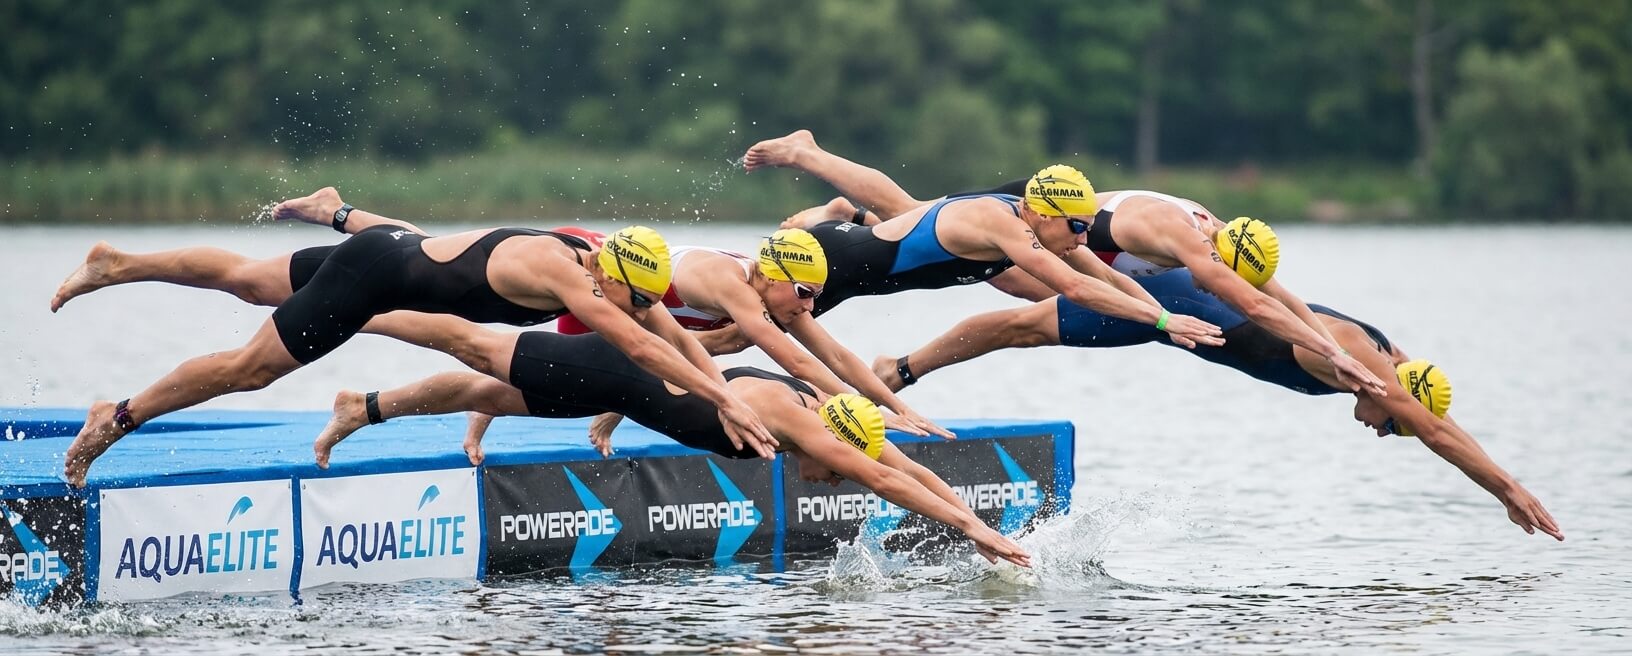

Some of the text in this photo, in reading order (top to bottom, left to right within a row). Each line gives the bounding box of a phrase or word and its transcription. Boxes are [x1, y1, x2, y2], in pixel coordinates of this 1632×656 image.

[951, 480, 1039, 511] WERADE
[500, 508, 616, 542] POWERADE
[648, 500, 755, 532] POWERADE
[115, 528, 279, 583] AQUAELITE
[315, 515, 466, 570] AQUAELITE
